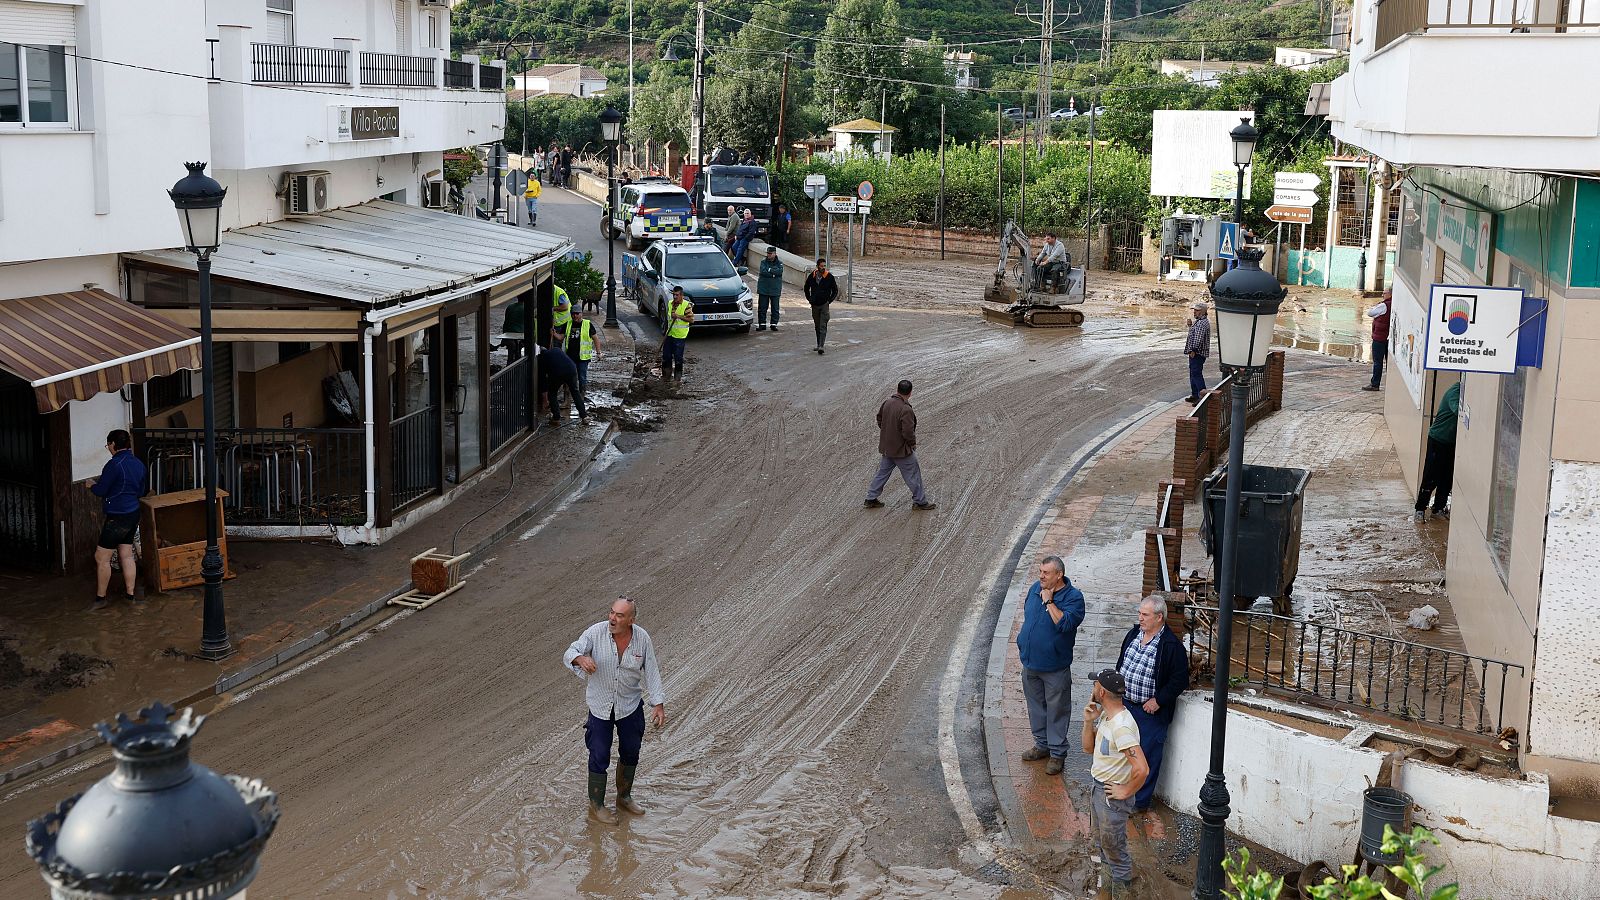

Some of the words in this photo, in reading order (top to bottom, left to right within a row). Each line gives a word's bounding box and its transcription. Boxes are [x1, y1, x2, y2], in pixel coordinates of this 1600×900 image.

[353, 109, 371, 132] Villa
[372, 109, 397, 135] Pepita
[1440, 336, 1476, 346] Loterías
[1478, 339, 1484, 347] y
[1440, 346, 1480, 356] Apuestas
[1482, 348, 1497, 356] del
[1438, 355, 1469, 364] Estado
